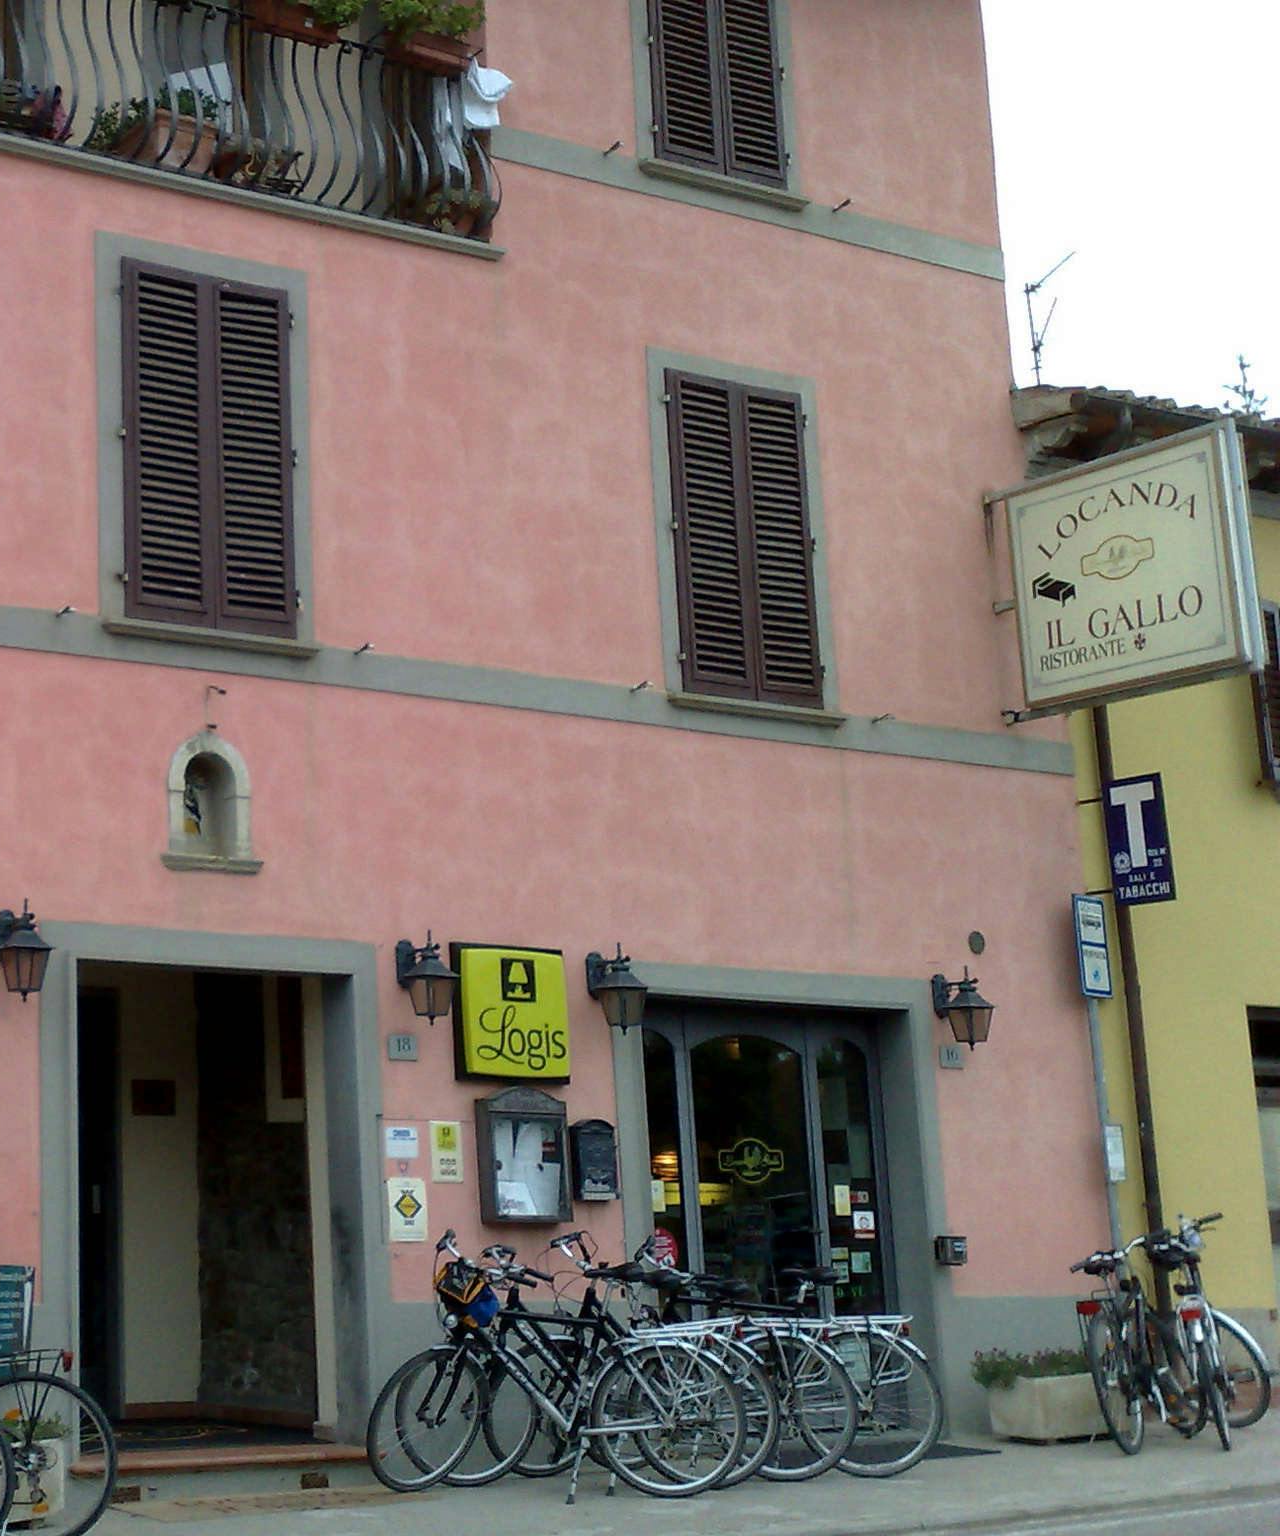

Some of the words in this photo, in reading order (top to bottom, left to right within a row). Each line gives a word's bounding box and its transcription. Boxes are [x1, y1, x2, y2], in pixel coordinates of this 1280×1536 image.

[1037, 481, 1197, 560] LOCANDA
[1046, 619, 1075, 650] IL
[1088, 585, 1203, 640] GALLO
[1039, 638, 1126, 672] RISTORANTE
[1109, 780, 1155, 869] T
[1119, 881, 1171, 900] TABACCHI
[395, 1037, 412, 1052] 18
[476, 1005, 567, 1071] Logis
